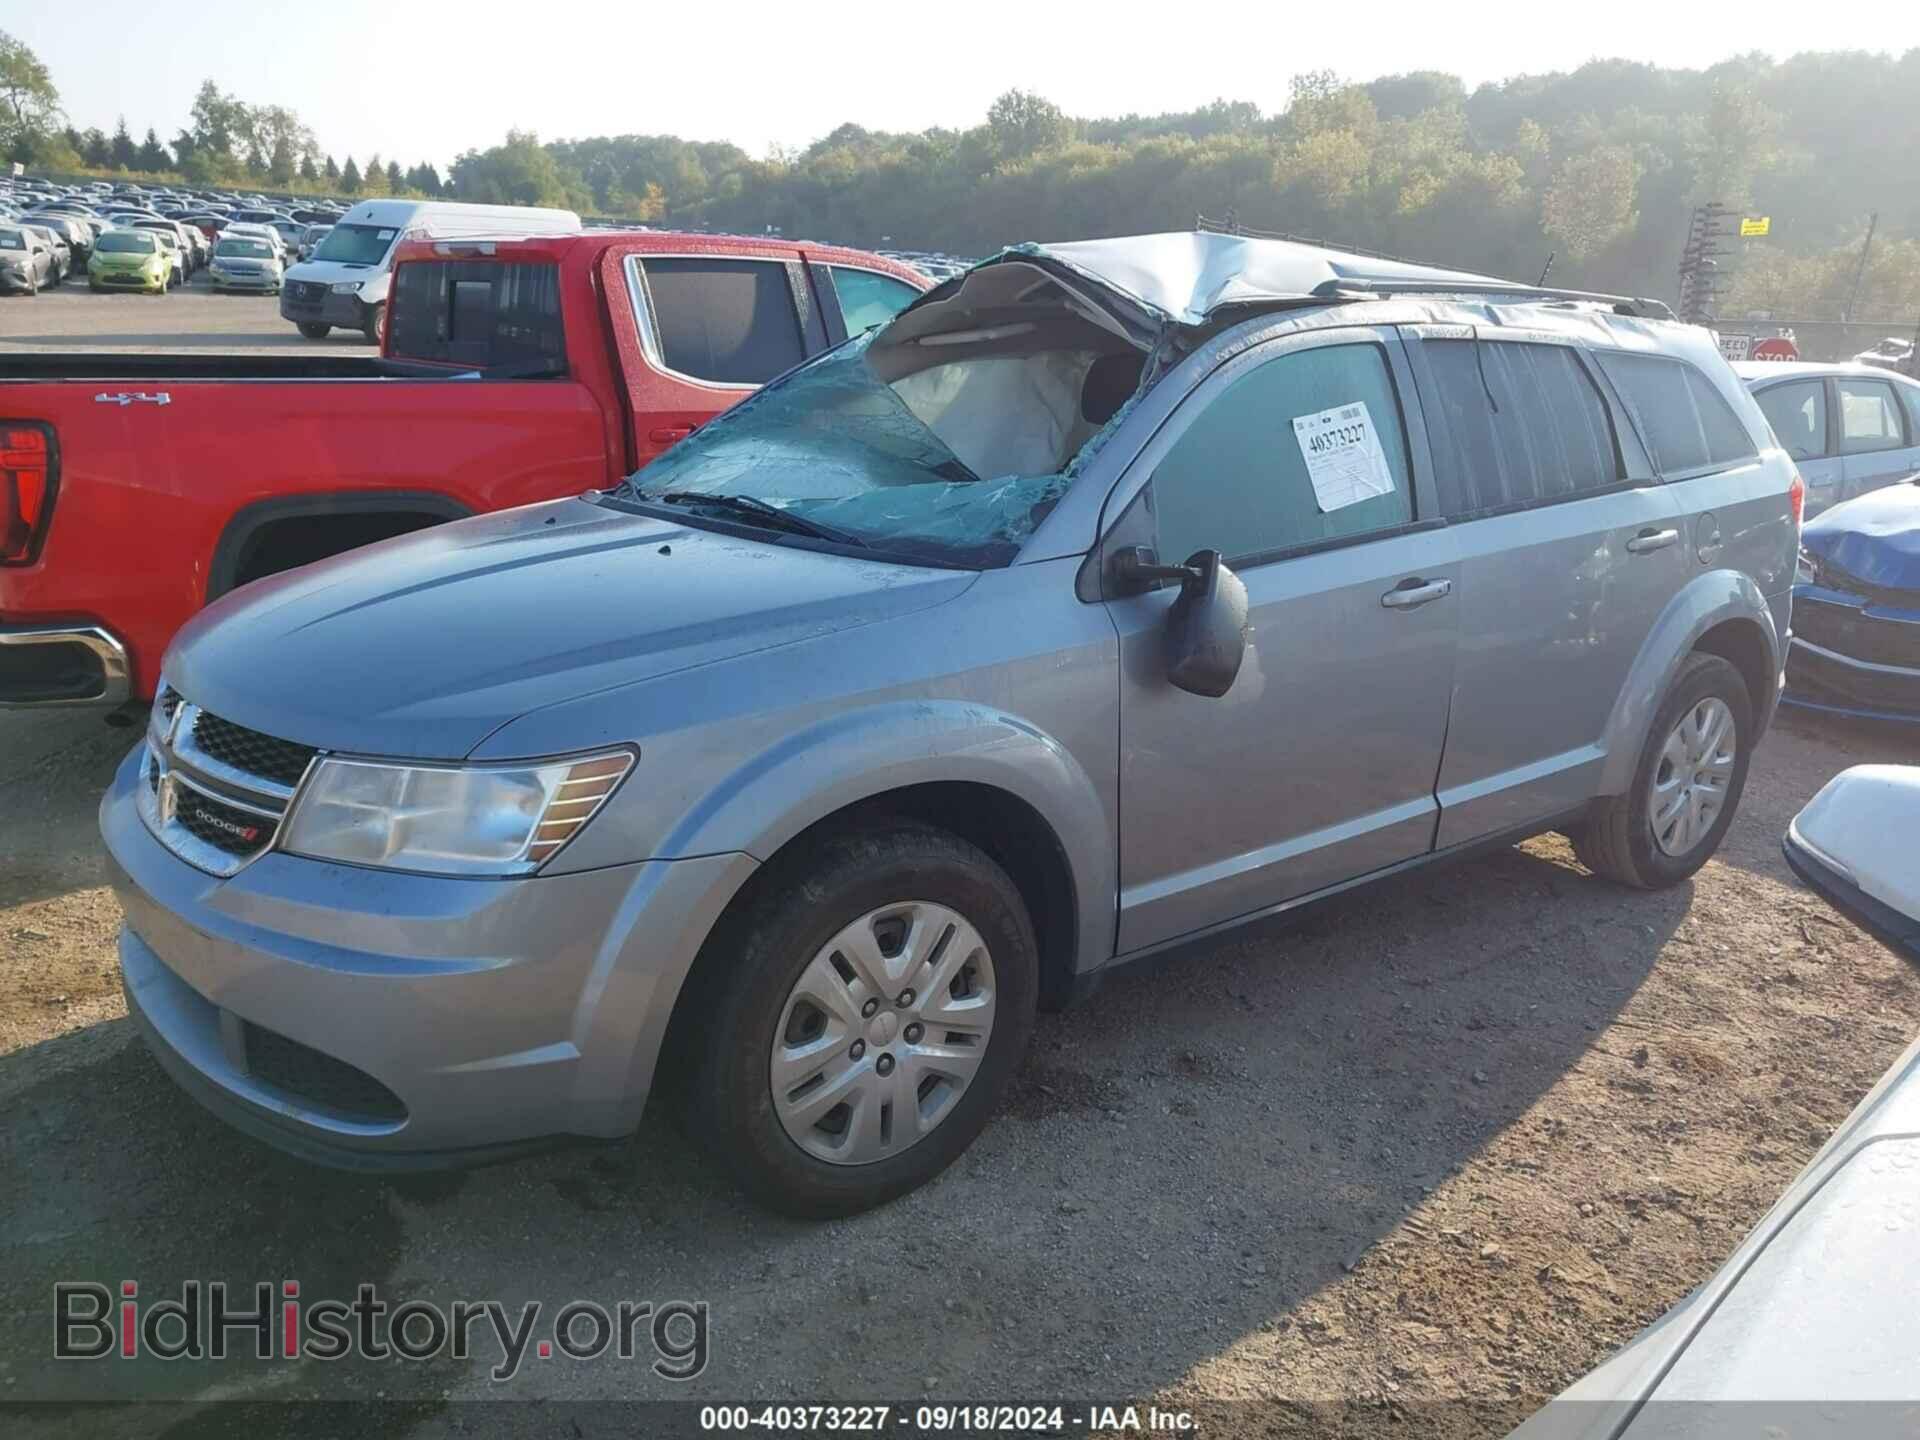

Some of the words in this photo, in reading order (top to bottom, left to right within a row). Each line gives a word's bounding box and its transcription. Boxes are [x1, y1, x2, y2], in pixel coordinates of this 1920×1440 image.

[1719, 339, 1747, 350] PEED
[1310, 423, 1366, 453] 40373227
[195, 807, 246, 837] DODGE
